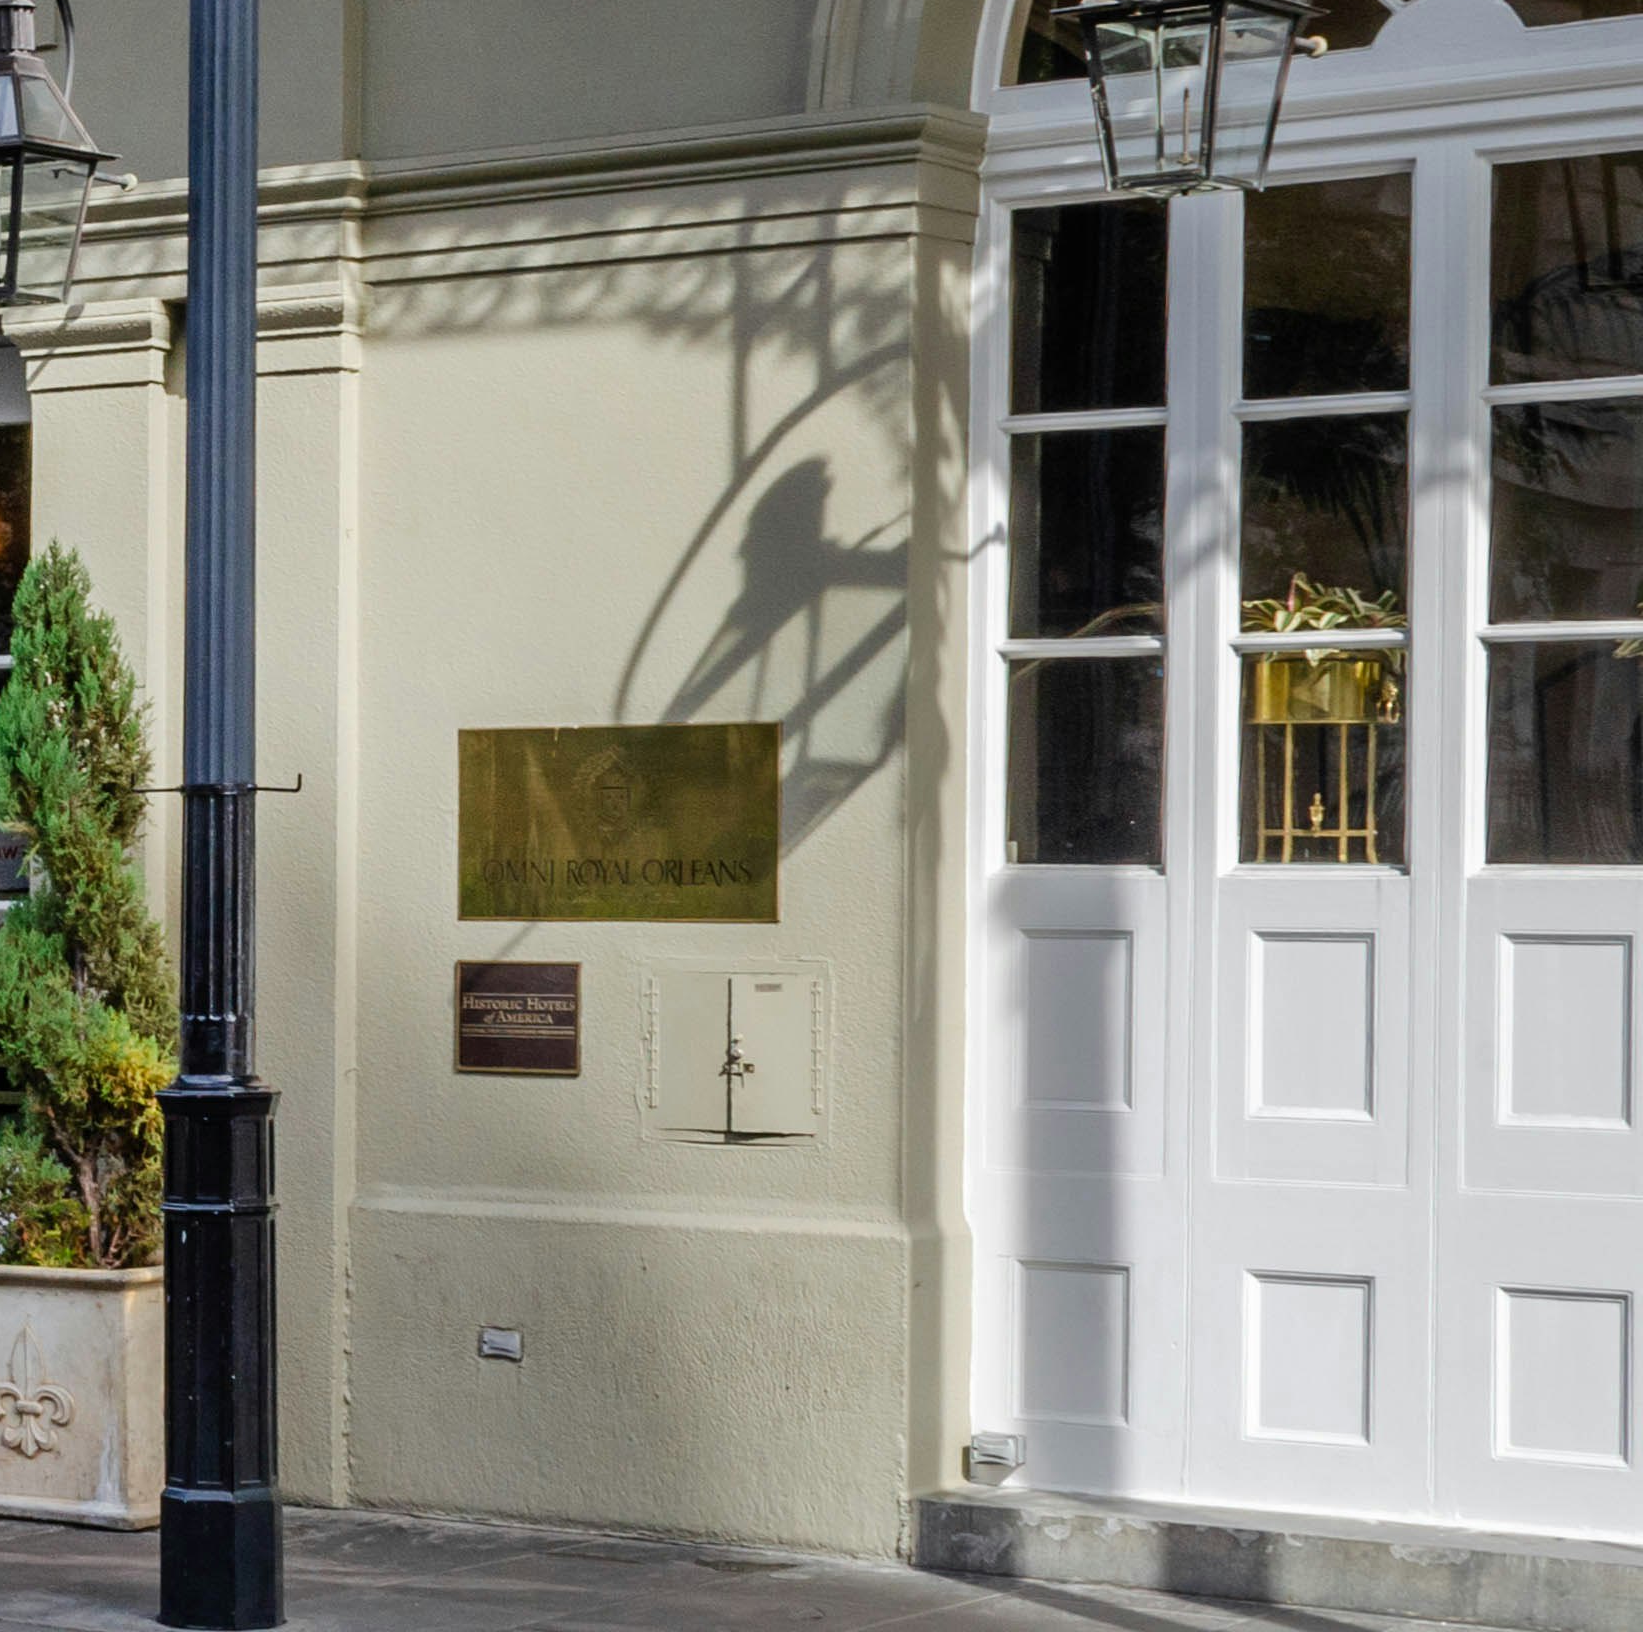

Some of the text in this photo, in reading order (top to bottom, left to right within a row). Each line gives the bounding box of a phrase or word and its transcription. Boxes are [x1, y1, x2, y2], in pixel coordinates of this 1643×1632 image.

[484, 858, 753, 888] OMNI ROYAL ORLEANS
[463, 995, 576, 1012] HISTORIC HOTELS
[483, 1010, 553, 1024] of AMERICA
